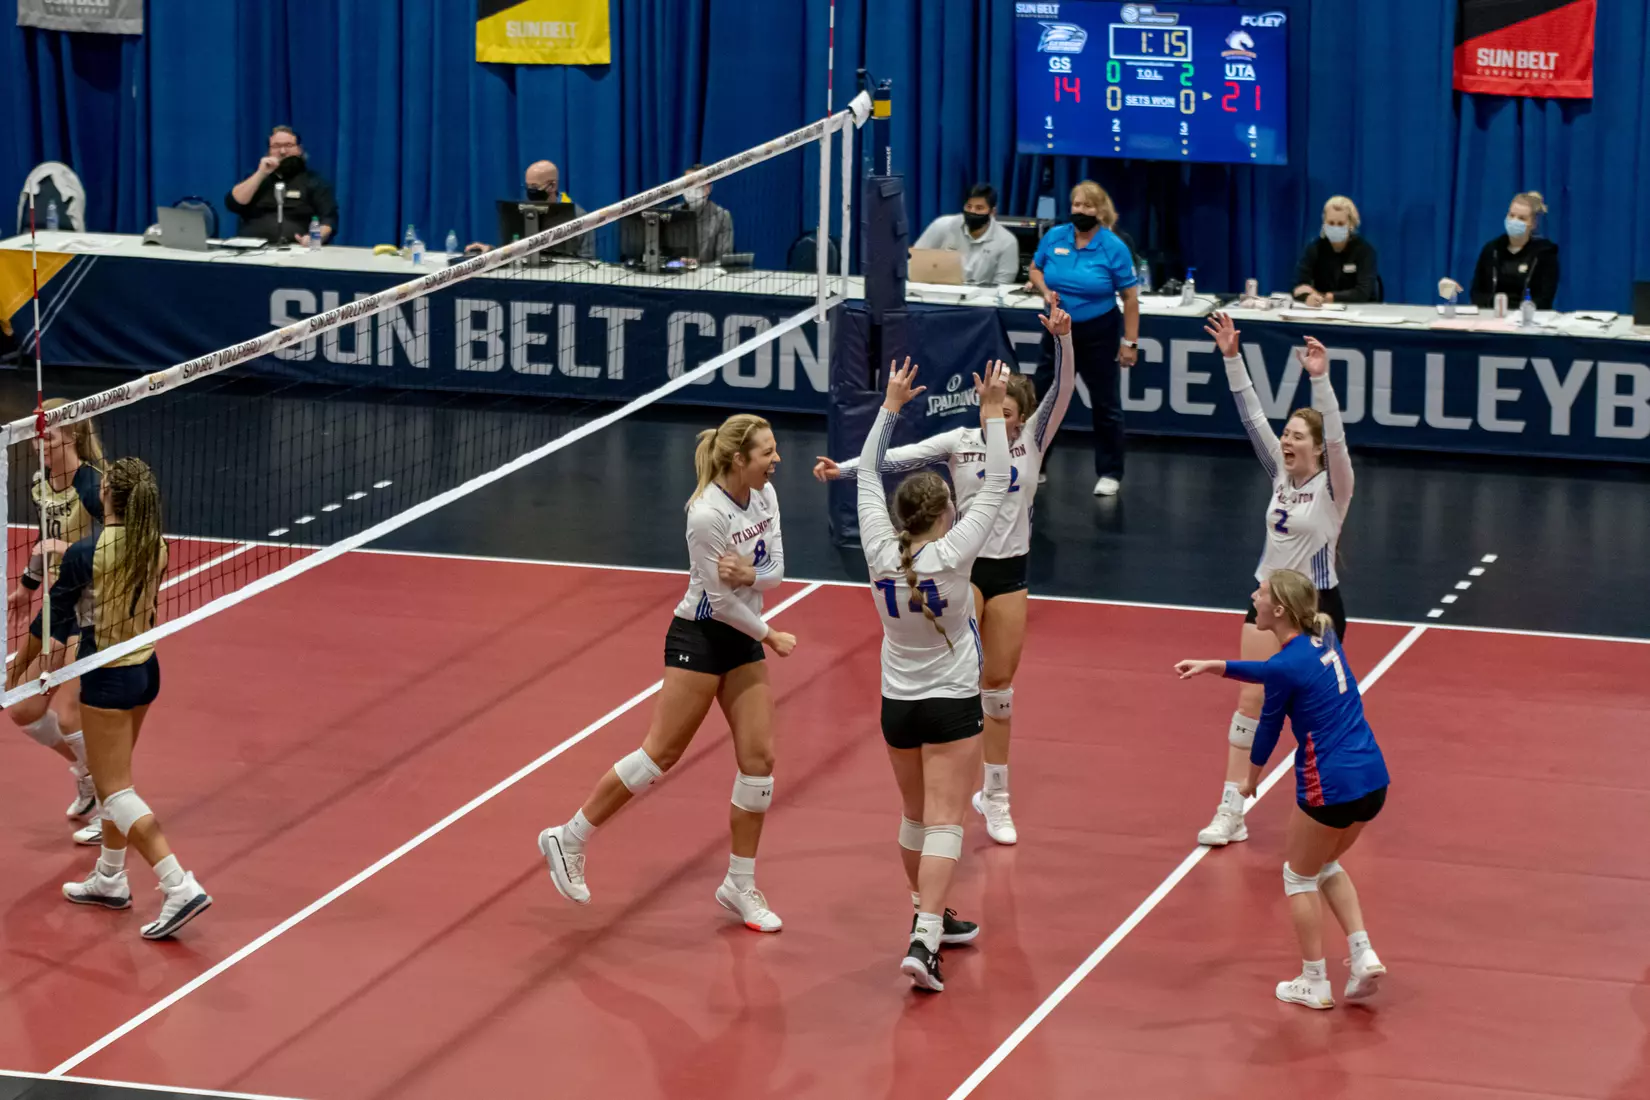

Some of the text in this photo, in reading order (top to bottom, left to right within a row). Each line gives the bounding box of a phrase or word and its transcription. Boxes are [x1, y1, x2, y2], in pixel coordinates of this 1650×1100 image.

[1016, 3, 1060, 15] SUN BELT
[505, 20, 578, 39] SUN BELT
[1241, 13, 1284, 28] FOLEY
[1141, 31, 1187, 57] 1:15
[1048, 56, 1072, 71] GS
[1476, 48, 1560, 70] SUN BELT
[1106, 59, 1121, 83] 0
[1180, 63, 1195, 87] 2
[1225, 63, 1256, 79] UTA
[1054, 76, 1081, 103] 14
[1106, 86, 1195, 114] 0 SETS WON 0
[1044, 115, 1054, 129] 1
[1111, 118, 1121, 132] 2
[1179, 121, 1189, 135] 3
[1247, 125, 1257, 138] 4
[270, 288, 429, 369] SUN
[455, 299, 644, 380] BELT
[183, 361, 200, 379] SUN
[1273, 508, 1289, 535] 2
[752, 538, 767, 567] 8
[1320, 647, 1348, 695] 7
